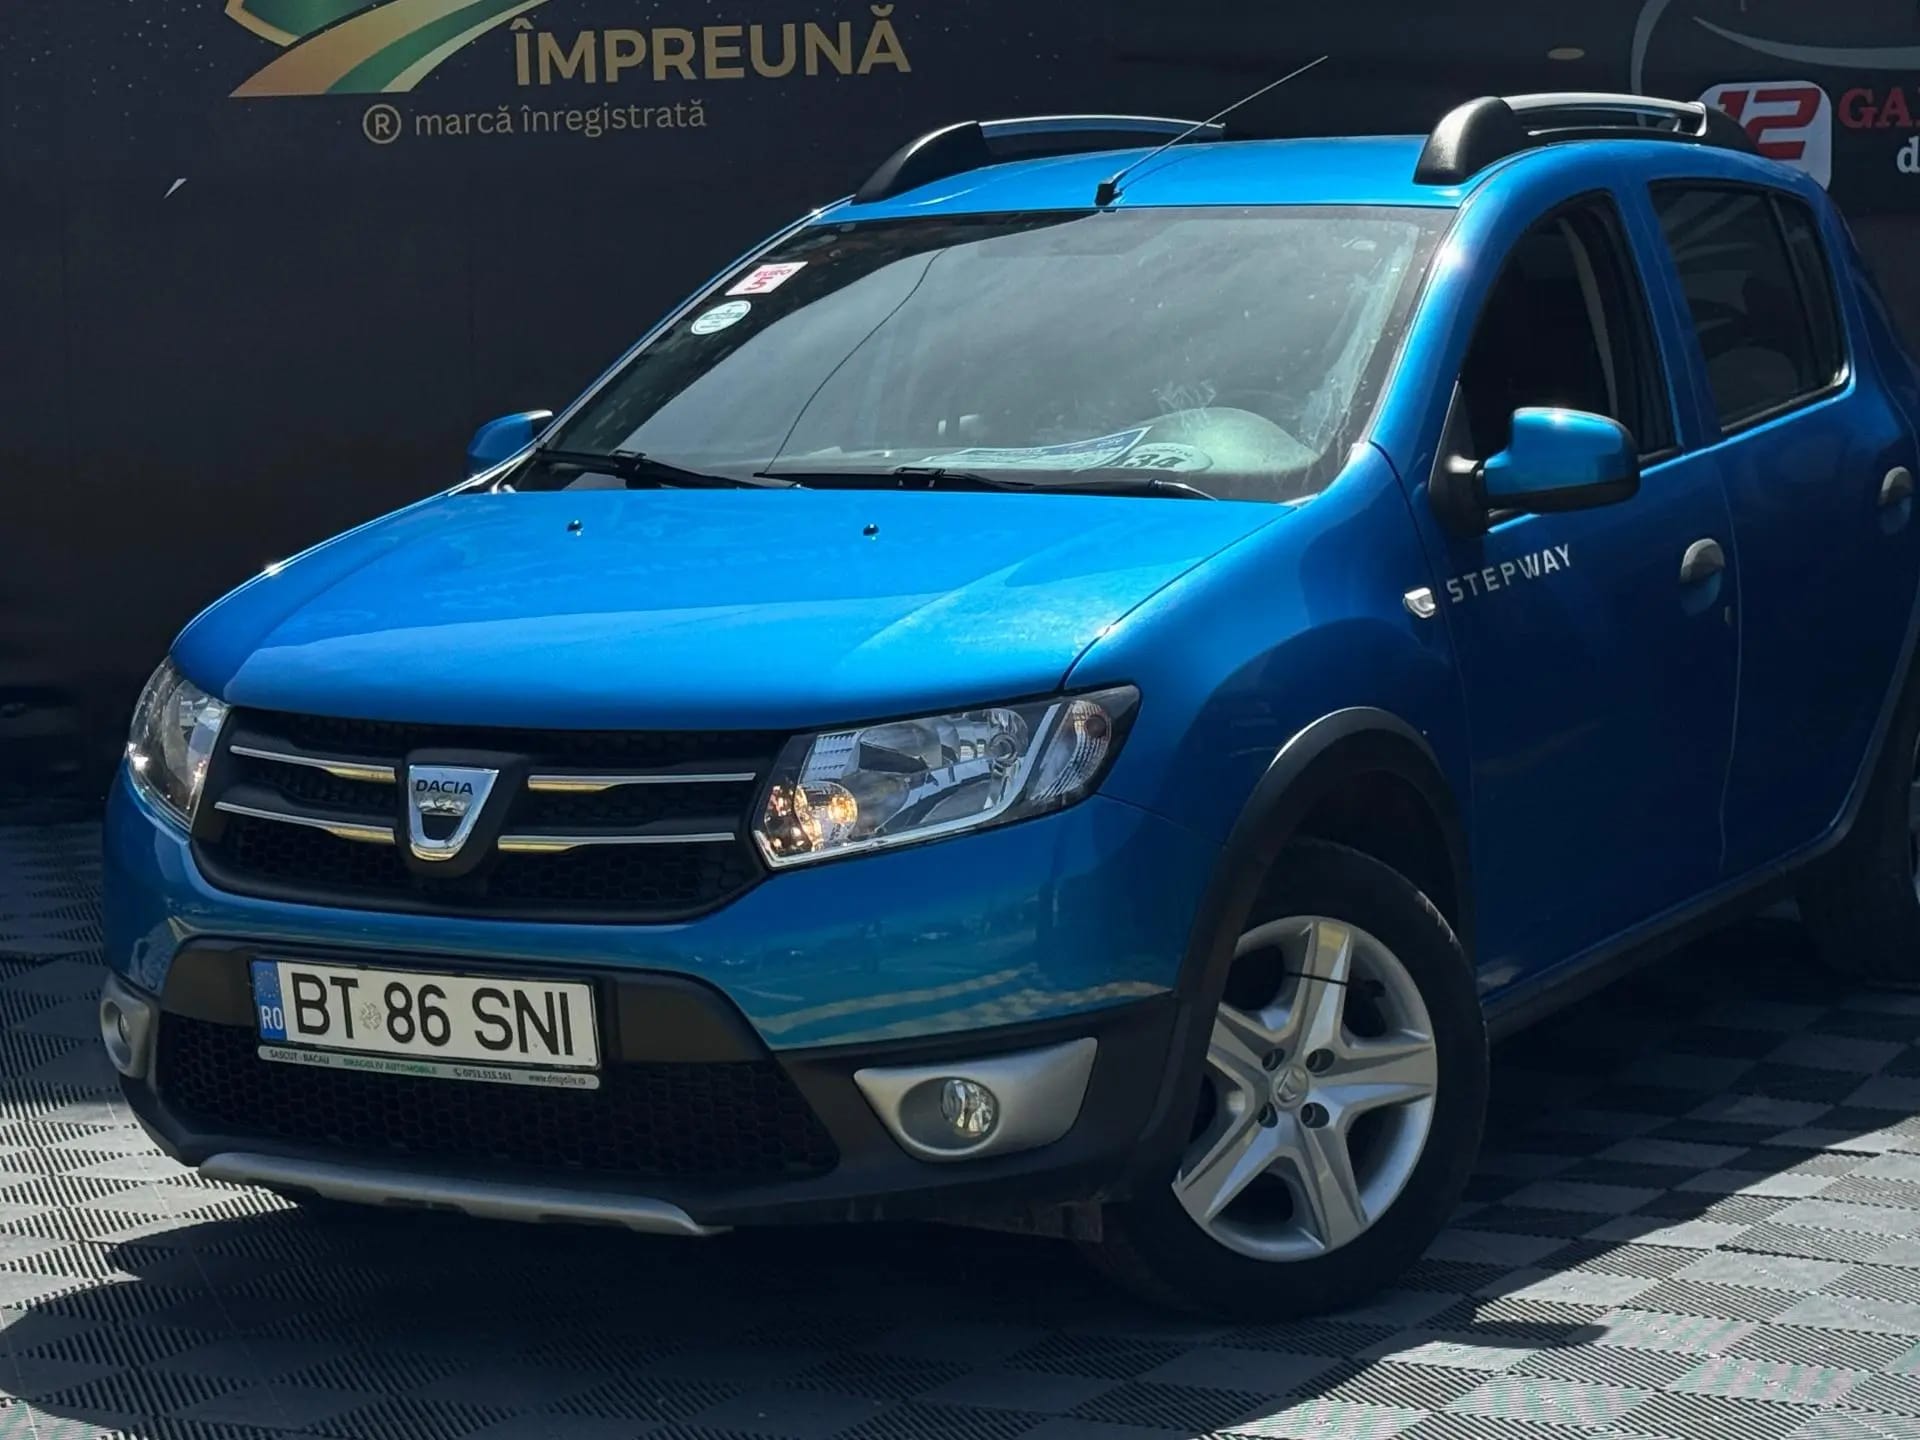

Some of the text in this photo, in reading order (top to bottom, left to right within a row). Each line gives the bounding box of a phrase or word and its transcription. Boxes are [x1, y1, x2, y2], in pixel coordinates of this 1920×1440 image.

[509, 4, 912, 86] ÎMPREUNĂ
[415, 104, 514, 137] marcă
[520, 99, 707, 138] înregistrată
[1837, 87, 1920, 129] GA
[743, 276, 774, 291] 5
[1446, 544, 1571, 603] STEPWAY
[416, 780, 474, 796] DACIA
[261, 1005, 284, 1031] RO
[291, 972, 575, 1056] BT 86 SNI
